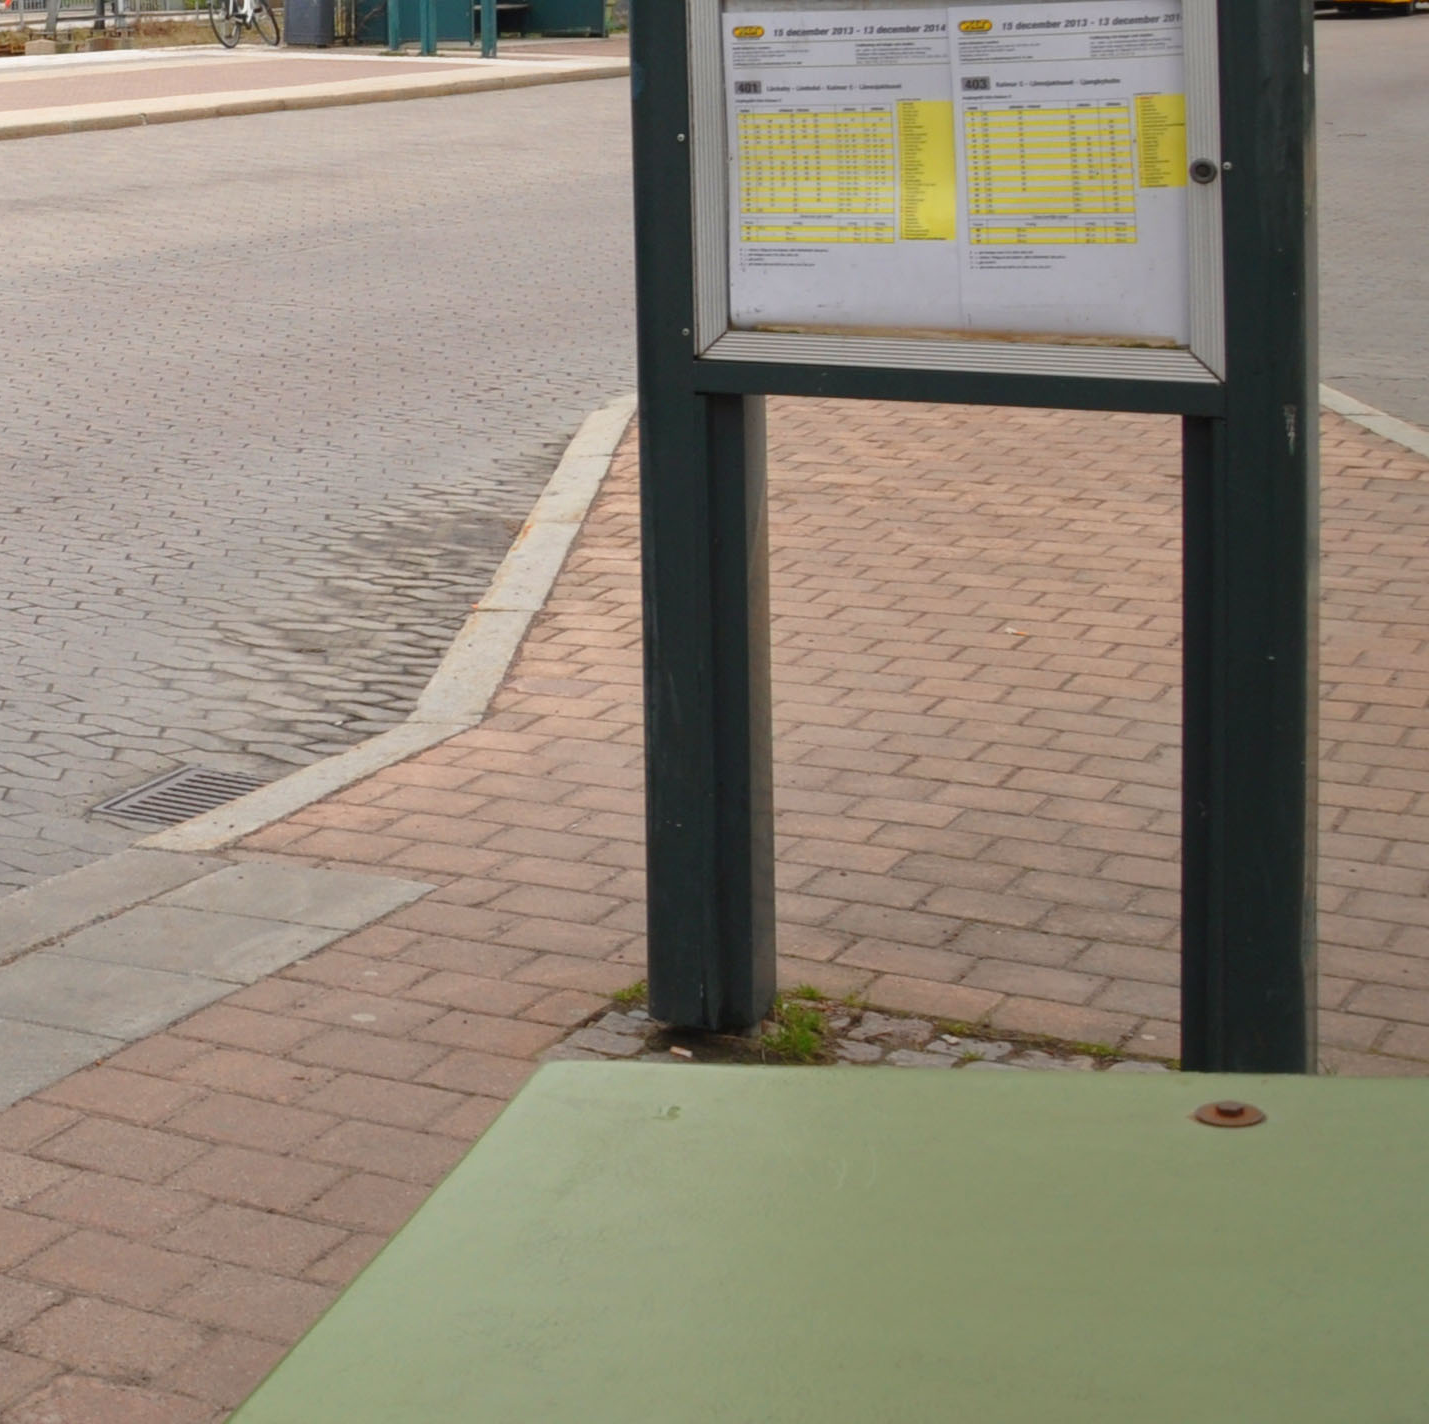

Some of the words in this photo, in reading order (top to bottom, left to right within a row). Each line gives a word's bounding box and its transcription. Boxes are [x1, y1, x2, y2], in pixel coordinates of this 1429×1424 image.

[1002, 22, 1013, 31] 15
[1015, 20, 1062, 30] december
[1064, 18, 1088, 28] 2013
[1098, 18, 1109, 27] 13
[1112, 15, 1160, 26] december
[1163, 13, 1183, 23] 201
[773, 29, 784, 37] 15
[786, 27, 829, 37] december
[831, 26, 855, 36] 2013
[863, 25, 875, 35] 13
[877, 24, 921, 34] december
[923, 24, 946, 33] 2014
[964, 79, 988, 90] 403
